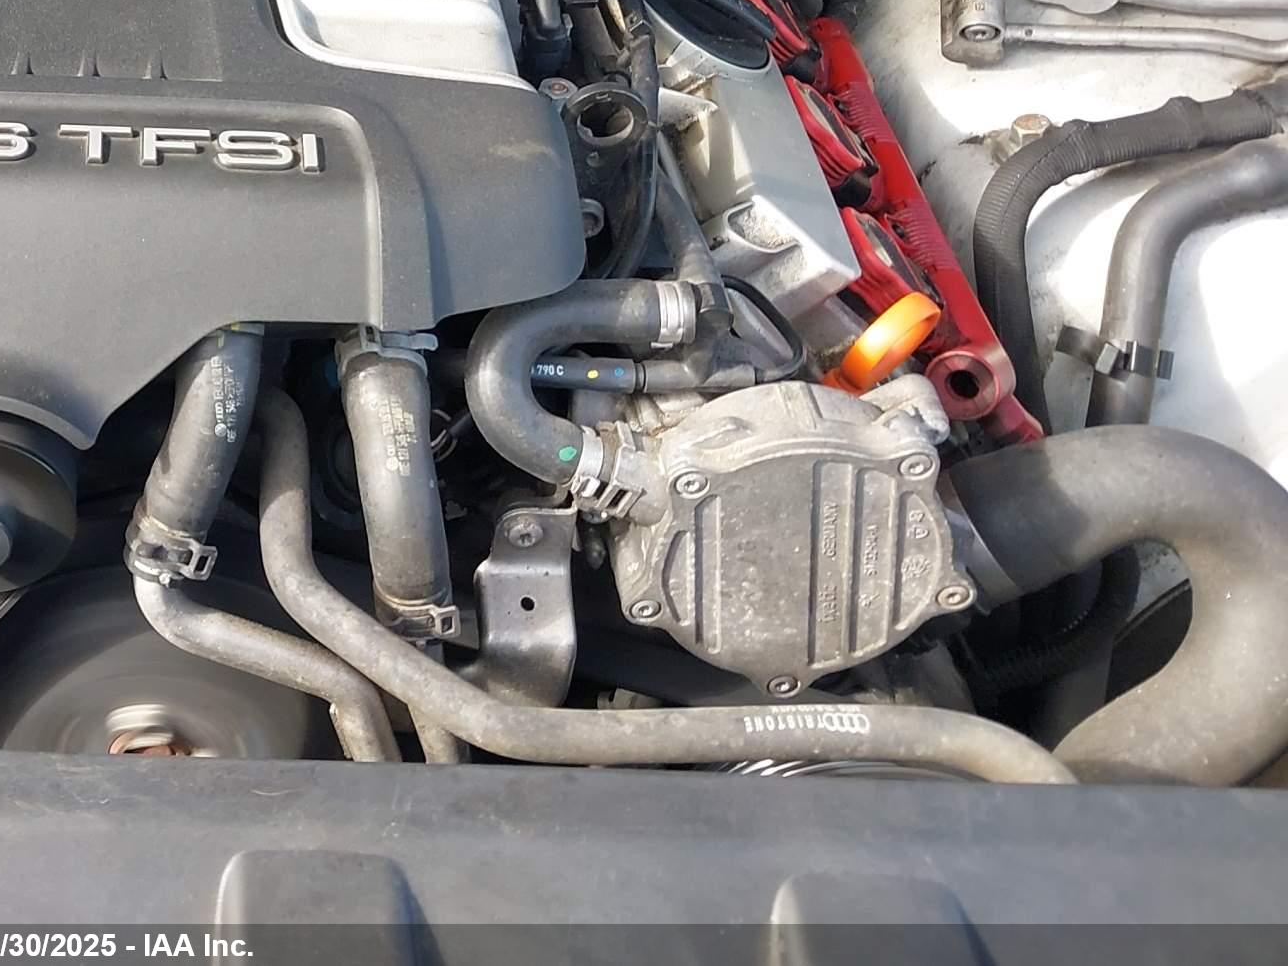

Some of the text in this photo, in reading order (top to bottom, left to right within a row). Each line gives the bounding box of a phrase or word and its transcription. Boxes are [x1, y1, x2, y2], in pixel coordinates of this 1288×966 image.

[58, 123, 321, 174] TFSI
[536, 363, 565, 376] 790 C
[822, 500, 838, 558] GERMANY
[743, 713, 824, 733] TRISTONE
